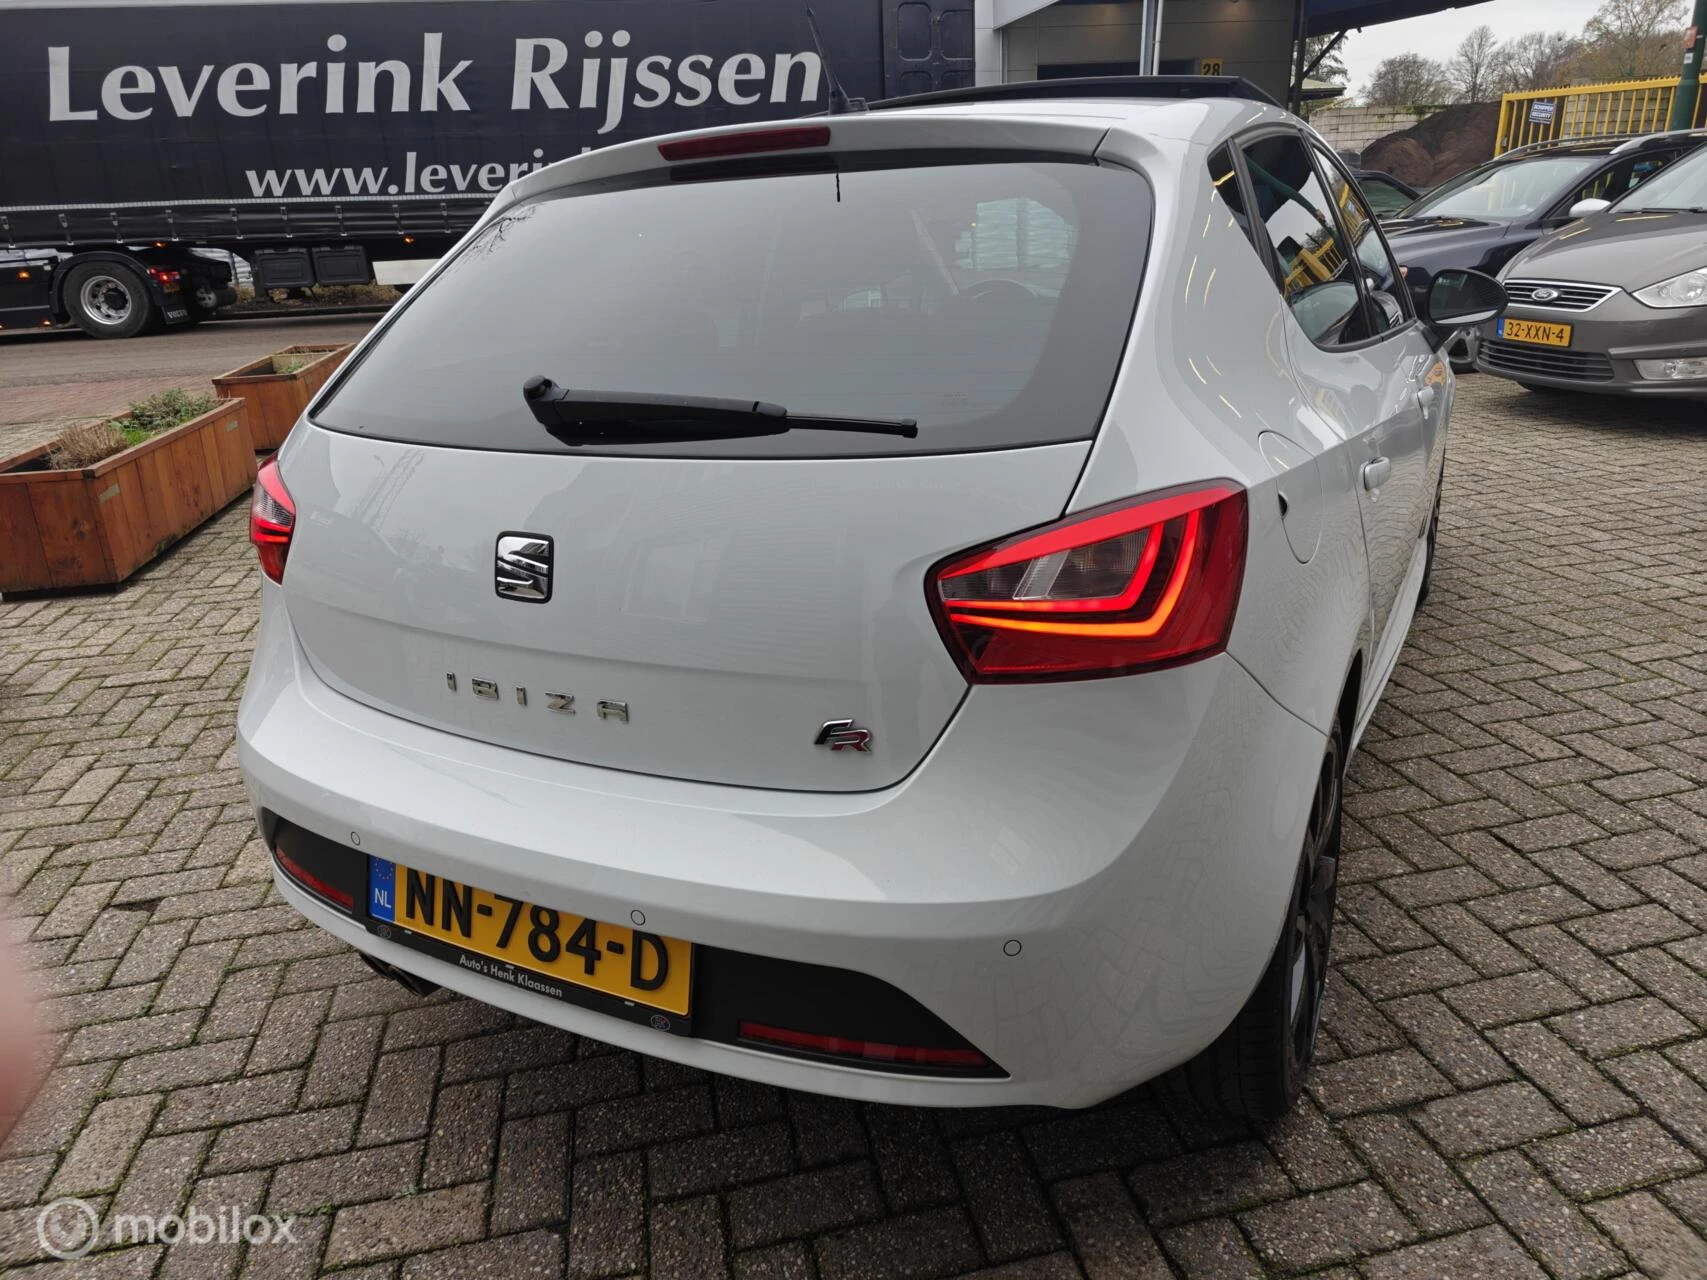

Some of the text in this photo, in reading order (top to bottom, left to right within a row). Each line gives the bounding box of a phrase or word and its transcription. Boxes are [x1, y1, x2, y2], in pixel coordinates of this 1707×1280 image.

[47, 29, 823, 135] Leverink Rijssen
[1202, 63, 1221, 76] 28
[245, 147, 592, 199] www.leveri
[1506, 321, 1565, 343] 32-XXN-4
[446, 671, 630, 724] IBIZA
[814, 719, 873, 753] FR
[374, 887, 392, 909] NL
[404, 866, 670, 992] NN-784-D
[459, 954, 563, 997] Auto's Henk Klaassen
